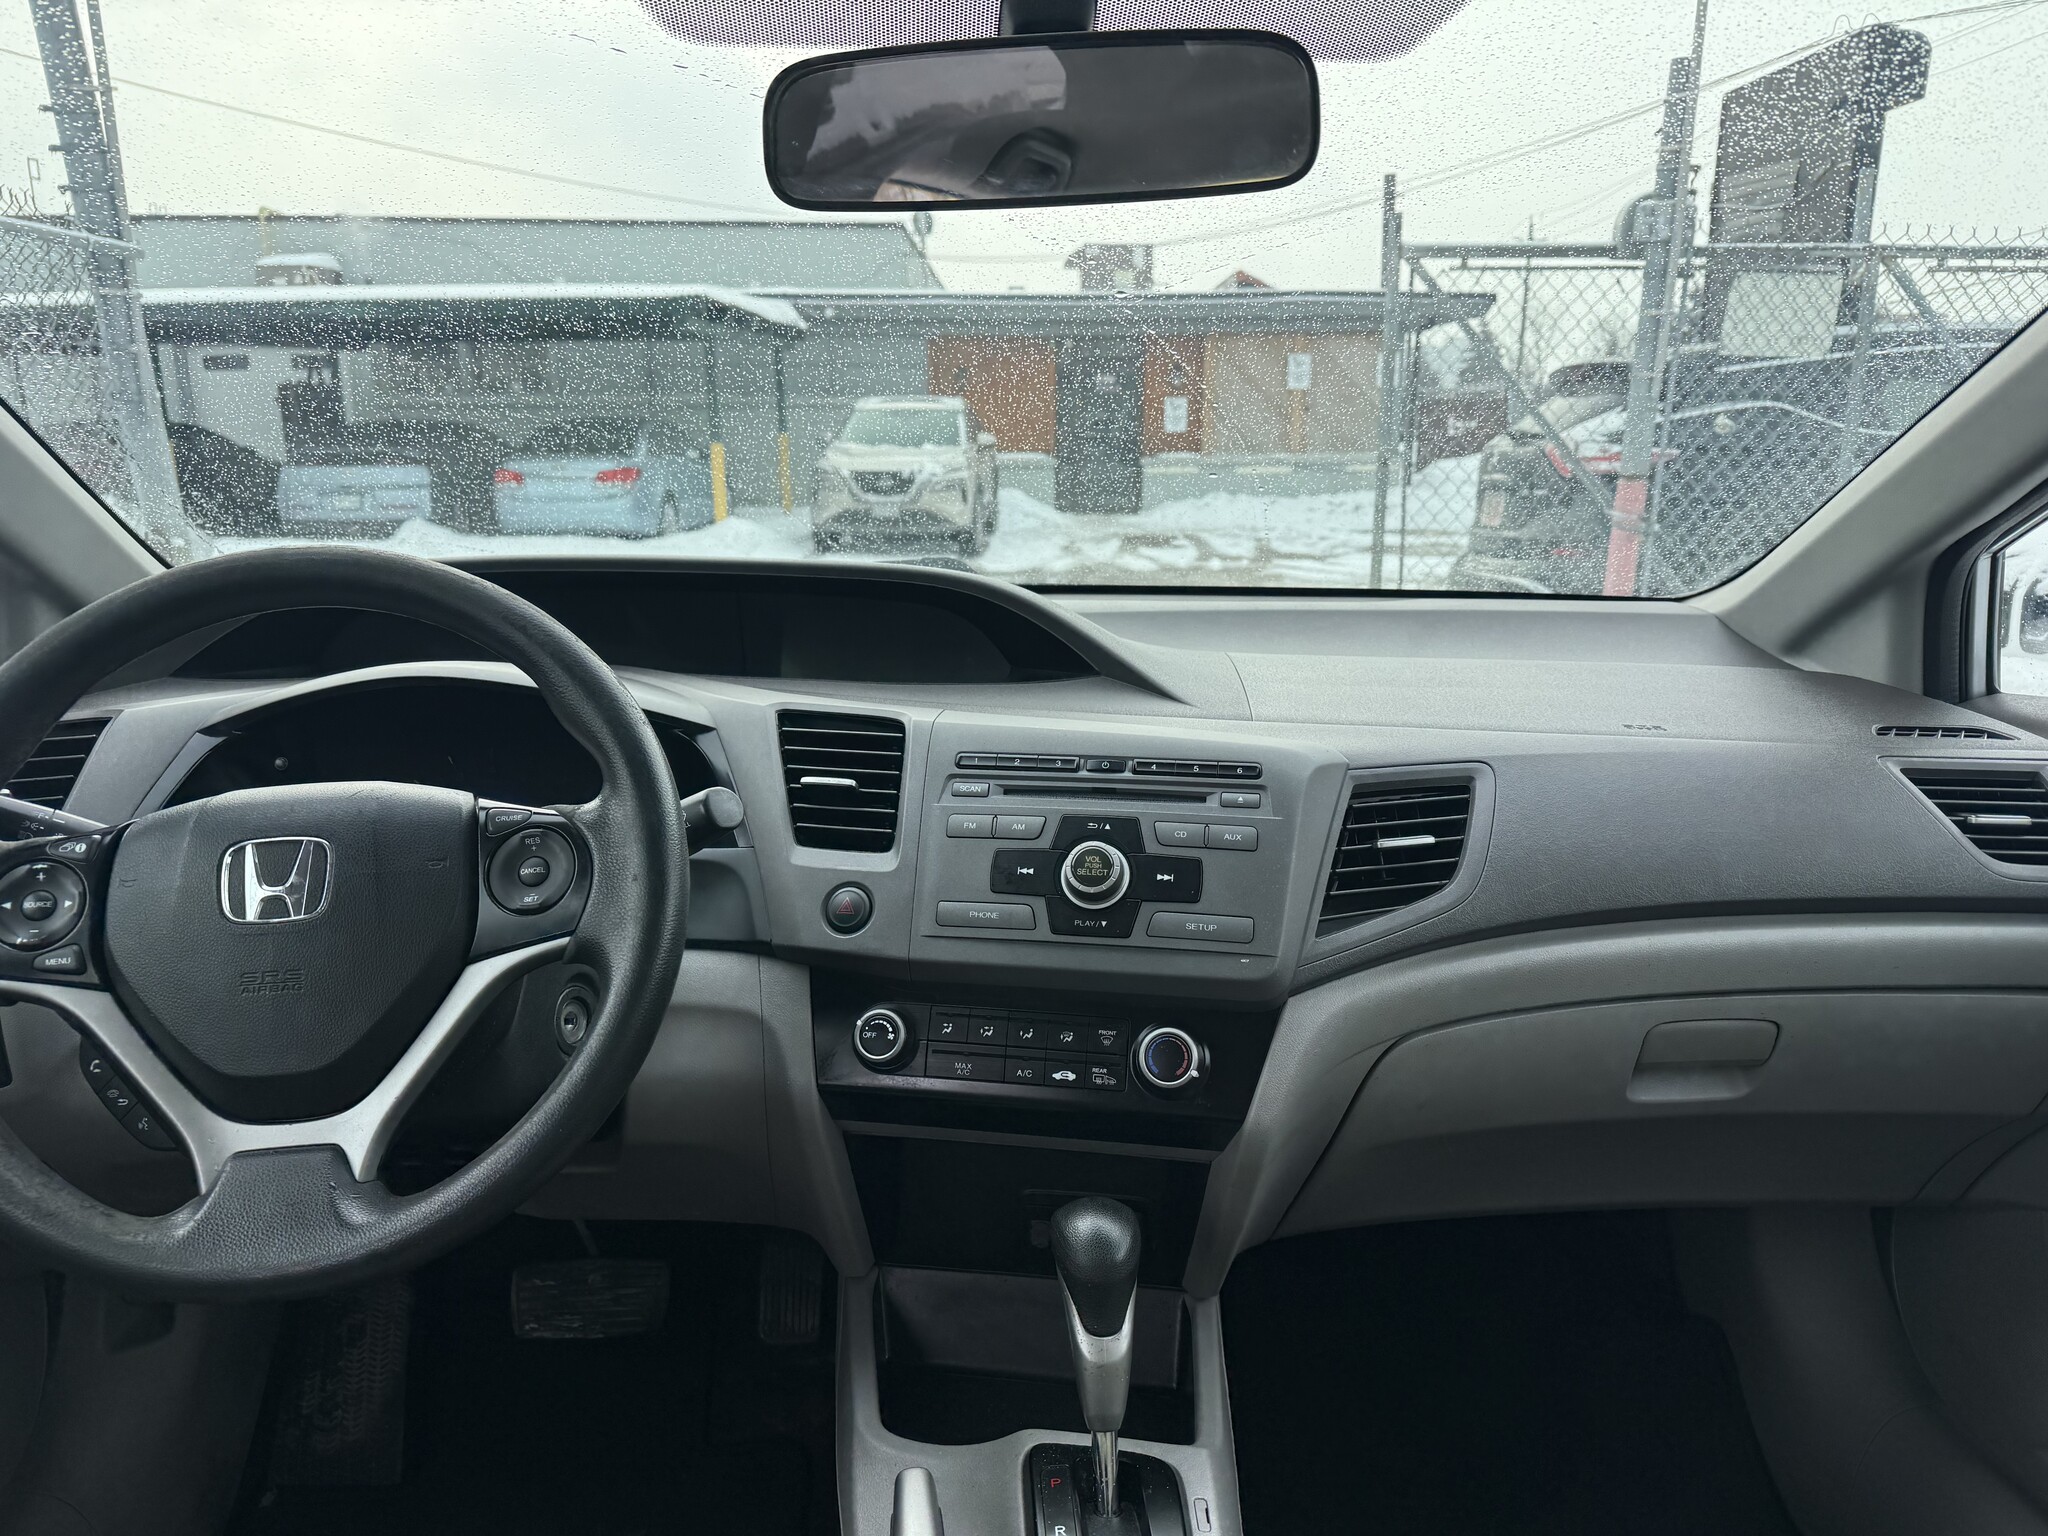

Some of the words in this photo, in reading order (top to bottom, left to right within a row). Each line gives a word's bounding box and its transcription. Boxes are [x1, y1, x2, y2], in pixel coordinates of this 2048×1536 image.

[959, 785, 981, 793] SCAN
[495, 814, 523, 822] CRUISE
[1174, 830, 1187, 838] CD
[1223, 833, 1242, 841] AUX
[525, 837, 541, 845] RES
[1085, 855, 1102, 863] VOL
[520, 866, 546, 875] CANCEL
[1076, 868, 1108, 876] SELECT
[523, 895, 539, 903] SET
[23, 900, 53, 908] SOURCE
[969, 910, 1000, 919] PHONE
[1185, 922, 1217, 931] SETUP
[45, 957, 71, 966] MENU
[240, 970, 304, 985] SRS
[240, 984, 304, 995] AIRBAG
[862, 1031, 878, 1039] OFF
[954, 1062, 973, 1070] MAX
[1016, 1069, 1033, 1077] A/C
[1050, 1478, 1061, 1488] P
[1054, 1525, 1067, 1536] R
